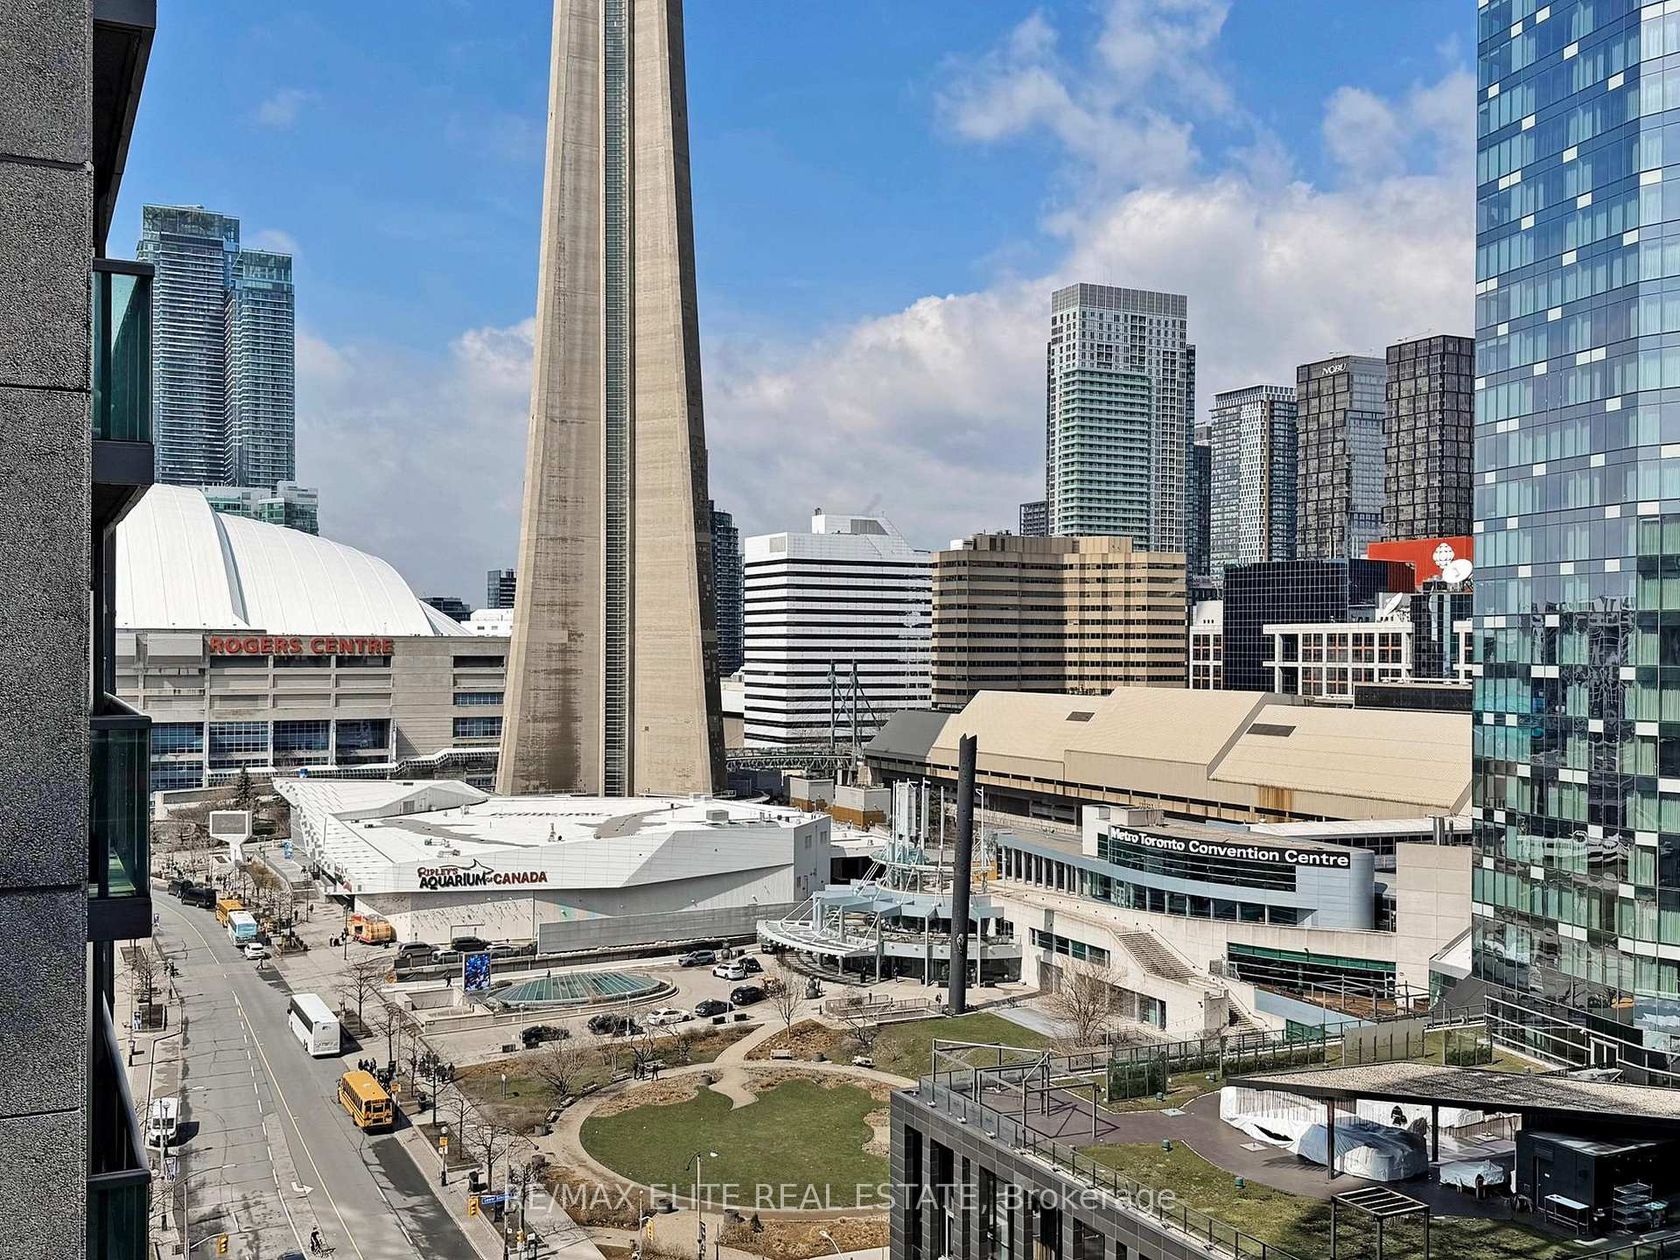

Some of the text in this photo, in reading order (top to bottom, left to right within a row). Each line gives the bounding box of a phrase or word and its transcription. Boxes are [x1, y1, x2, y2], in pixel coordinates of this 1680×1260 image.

[1322, 363, 1346, 376] NOBU
[210, 636, 395, 656] ROGERS CENTRE
[1110, 827, 1350, 867] Metro Toronto Convention Centre
[419, 872, 487, 890] AQUARIUM
[493, 871, 548, 885] CANADA
